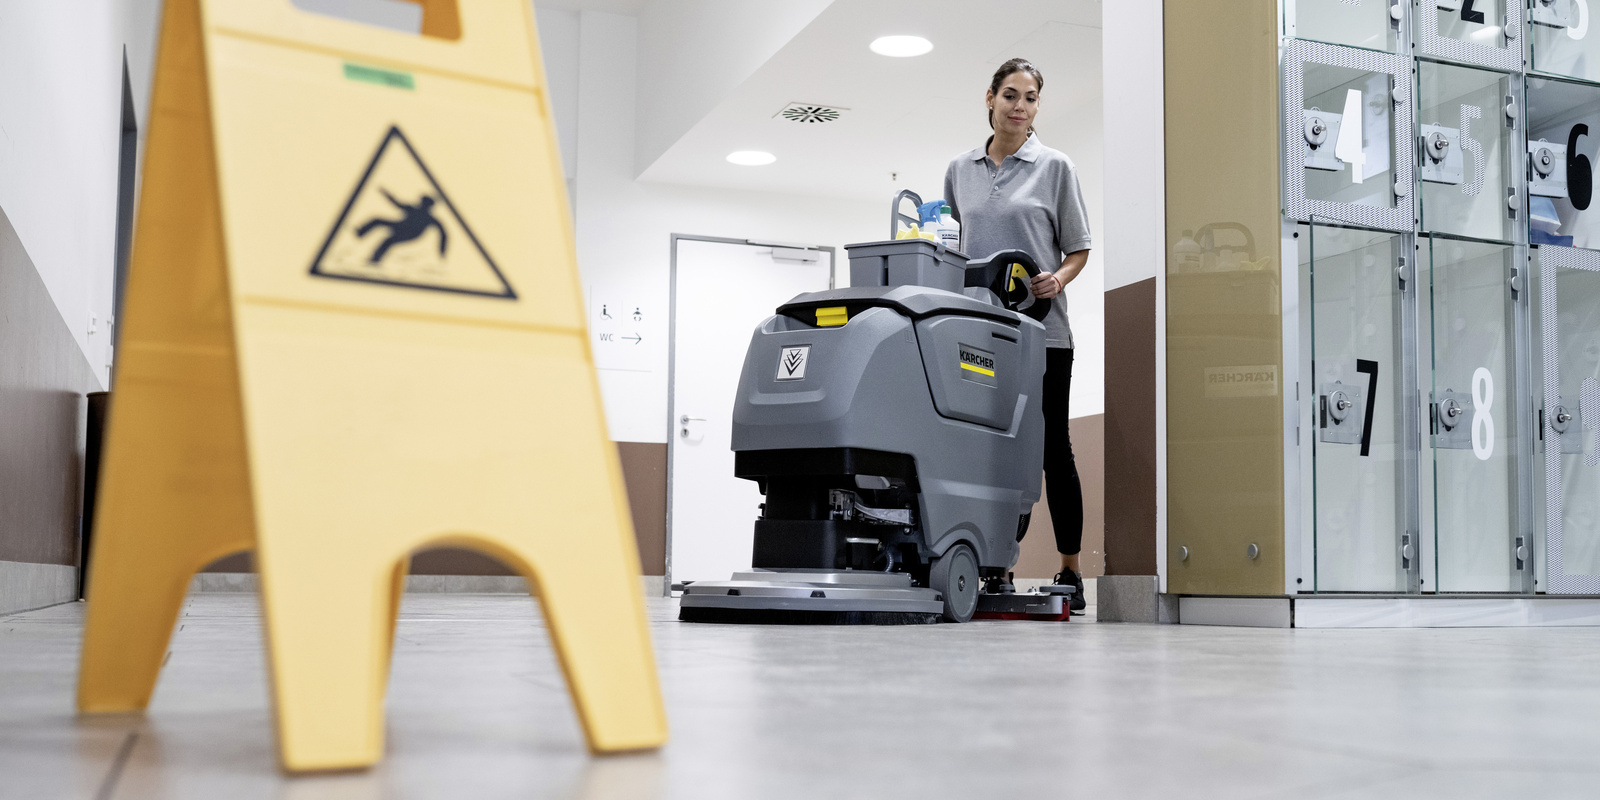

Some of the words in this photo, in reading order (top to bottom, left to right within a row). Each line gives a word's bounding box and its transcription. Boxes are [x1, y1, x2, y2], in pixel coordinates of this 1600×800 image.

[1334, 88, 1366, 184] 4
[1460, 103, 1485, 197] 5
[1566, 123, 1592, 211] 6
[600, 333, 614, 342] WC
[960, 350, 994, 369] KÄRCHER
[1356, 358, 1378, 457] 7
[1471, 366, 1495, 461] 8
[1580, 376, 1600, 467] 9
